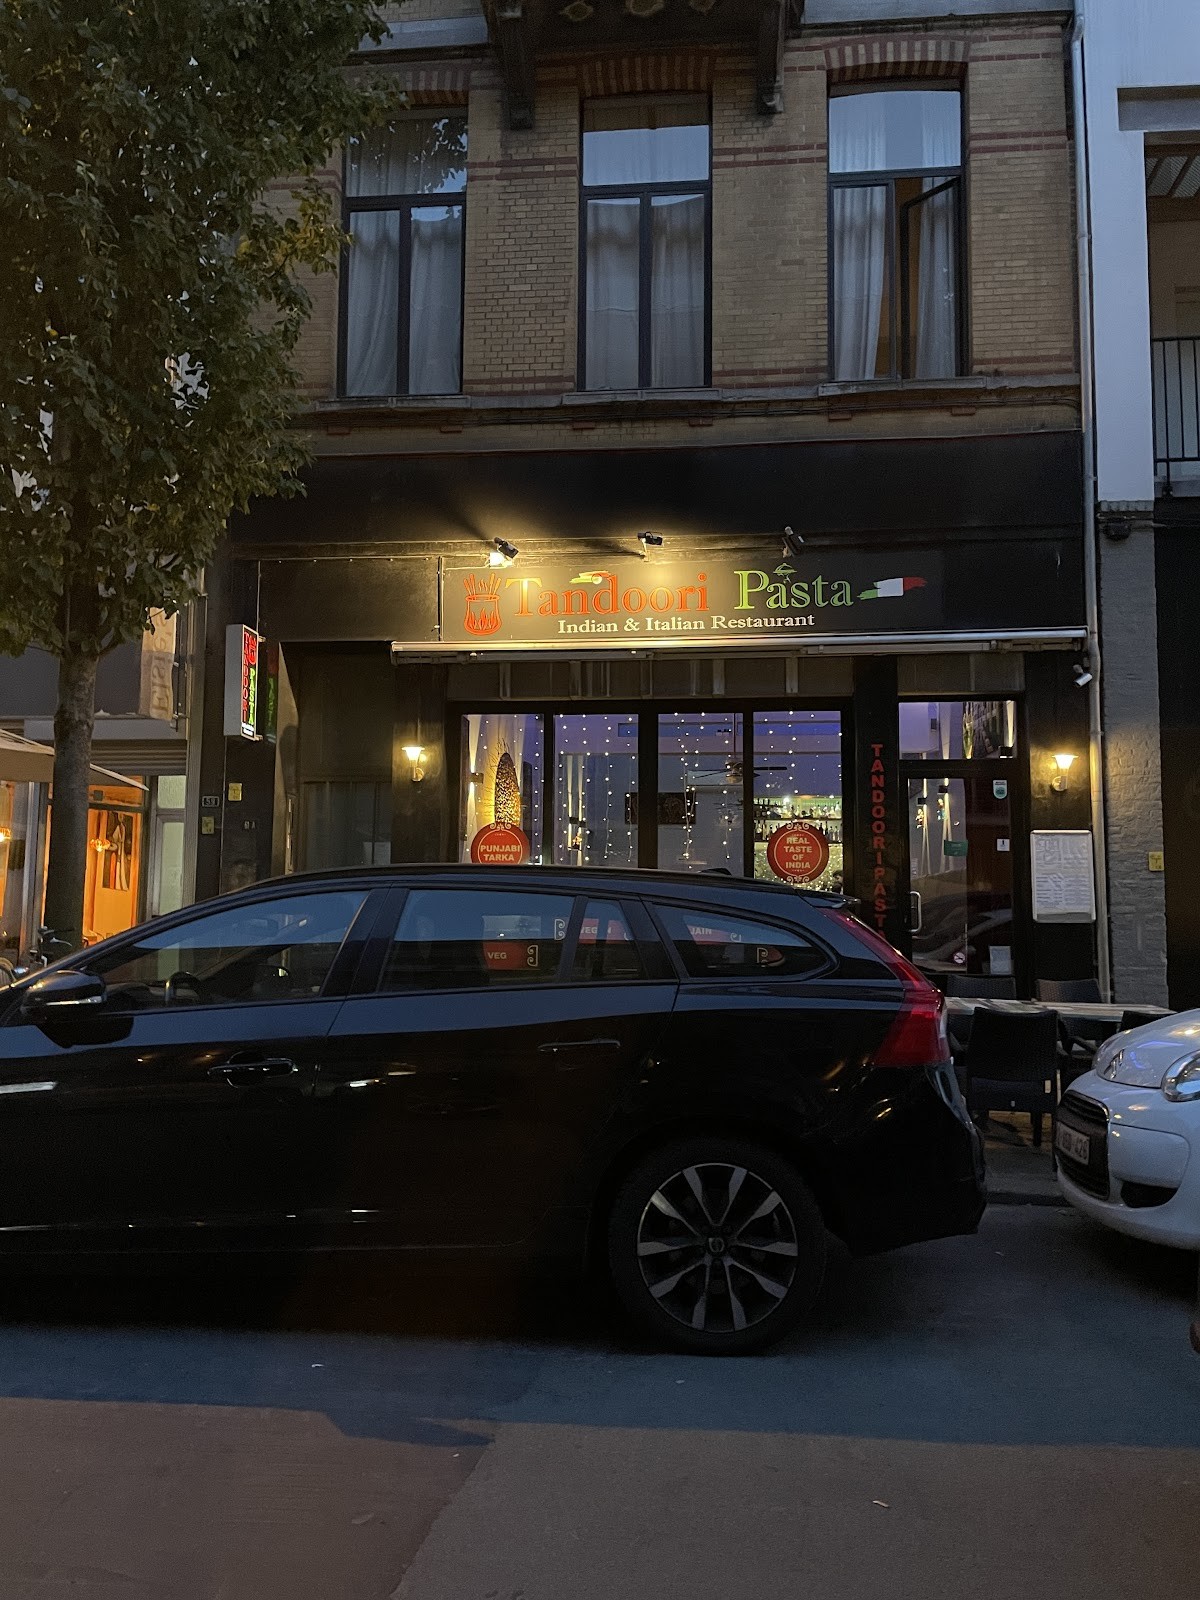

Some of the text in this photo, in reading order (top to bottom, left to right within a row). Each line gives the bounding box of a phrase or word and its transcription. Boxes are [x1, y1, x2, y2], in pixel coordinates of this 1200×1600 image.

[505, 570, 854, 616] Tandoori Pasta
[558, 614, 815, 634] Indian & Italian Restaurant
[480, 844, 521, 852] PUNJABI
[792, 853, 804, 861] OF
[785, 861, 810, 869] INDIA
[487, 952, 507, 960] VEG
